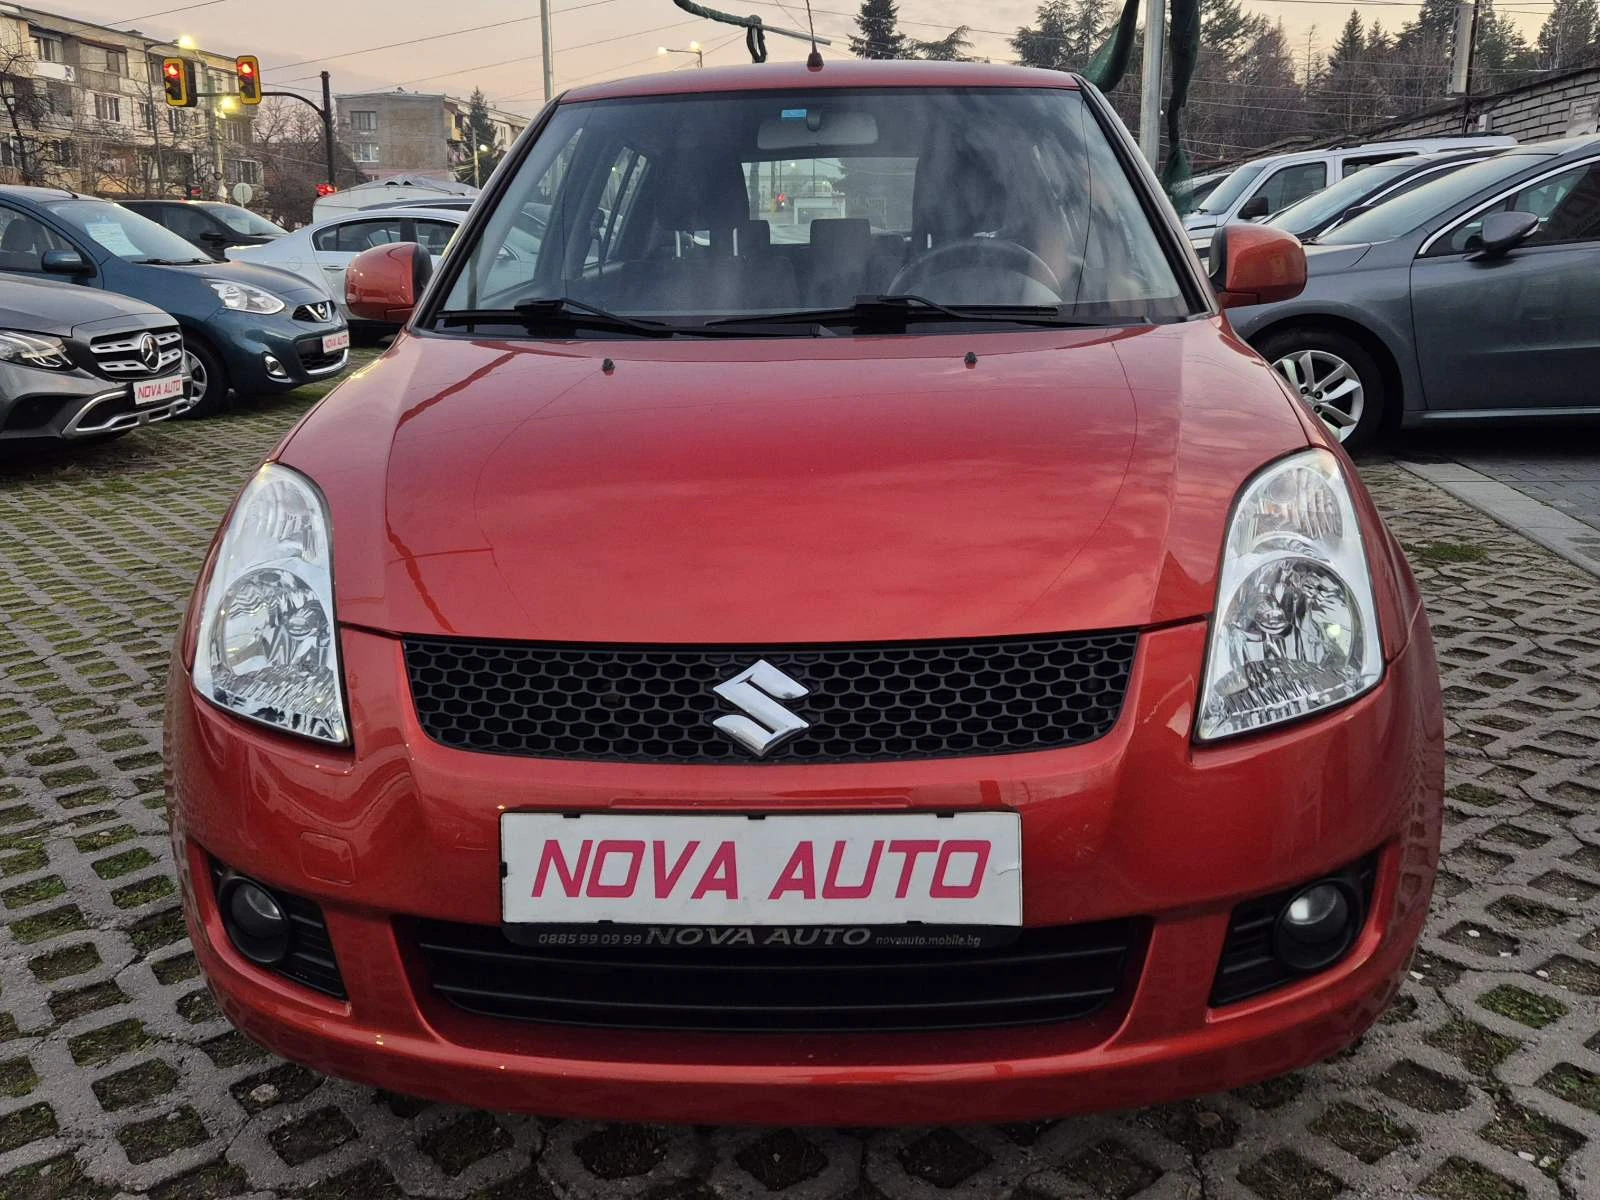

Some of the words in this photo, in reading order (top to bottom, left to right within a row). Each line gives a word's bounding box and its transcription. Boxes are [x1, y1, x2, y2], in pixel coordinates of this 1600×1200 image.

[138, 384, 161, 398] NOVA
[164, 380, 181, 394] AUTO
[532, 839, 738, 900] NOVA
[769, 839, 992, 900] AUTO
[645, 927, 755, 945] NOVA
[763, 927, 872, 945] AUTO
